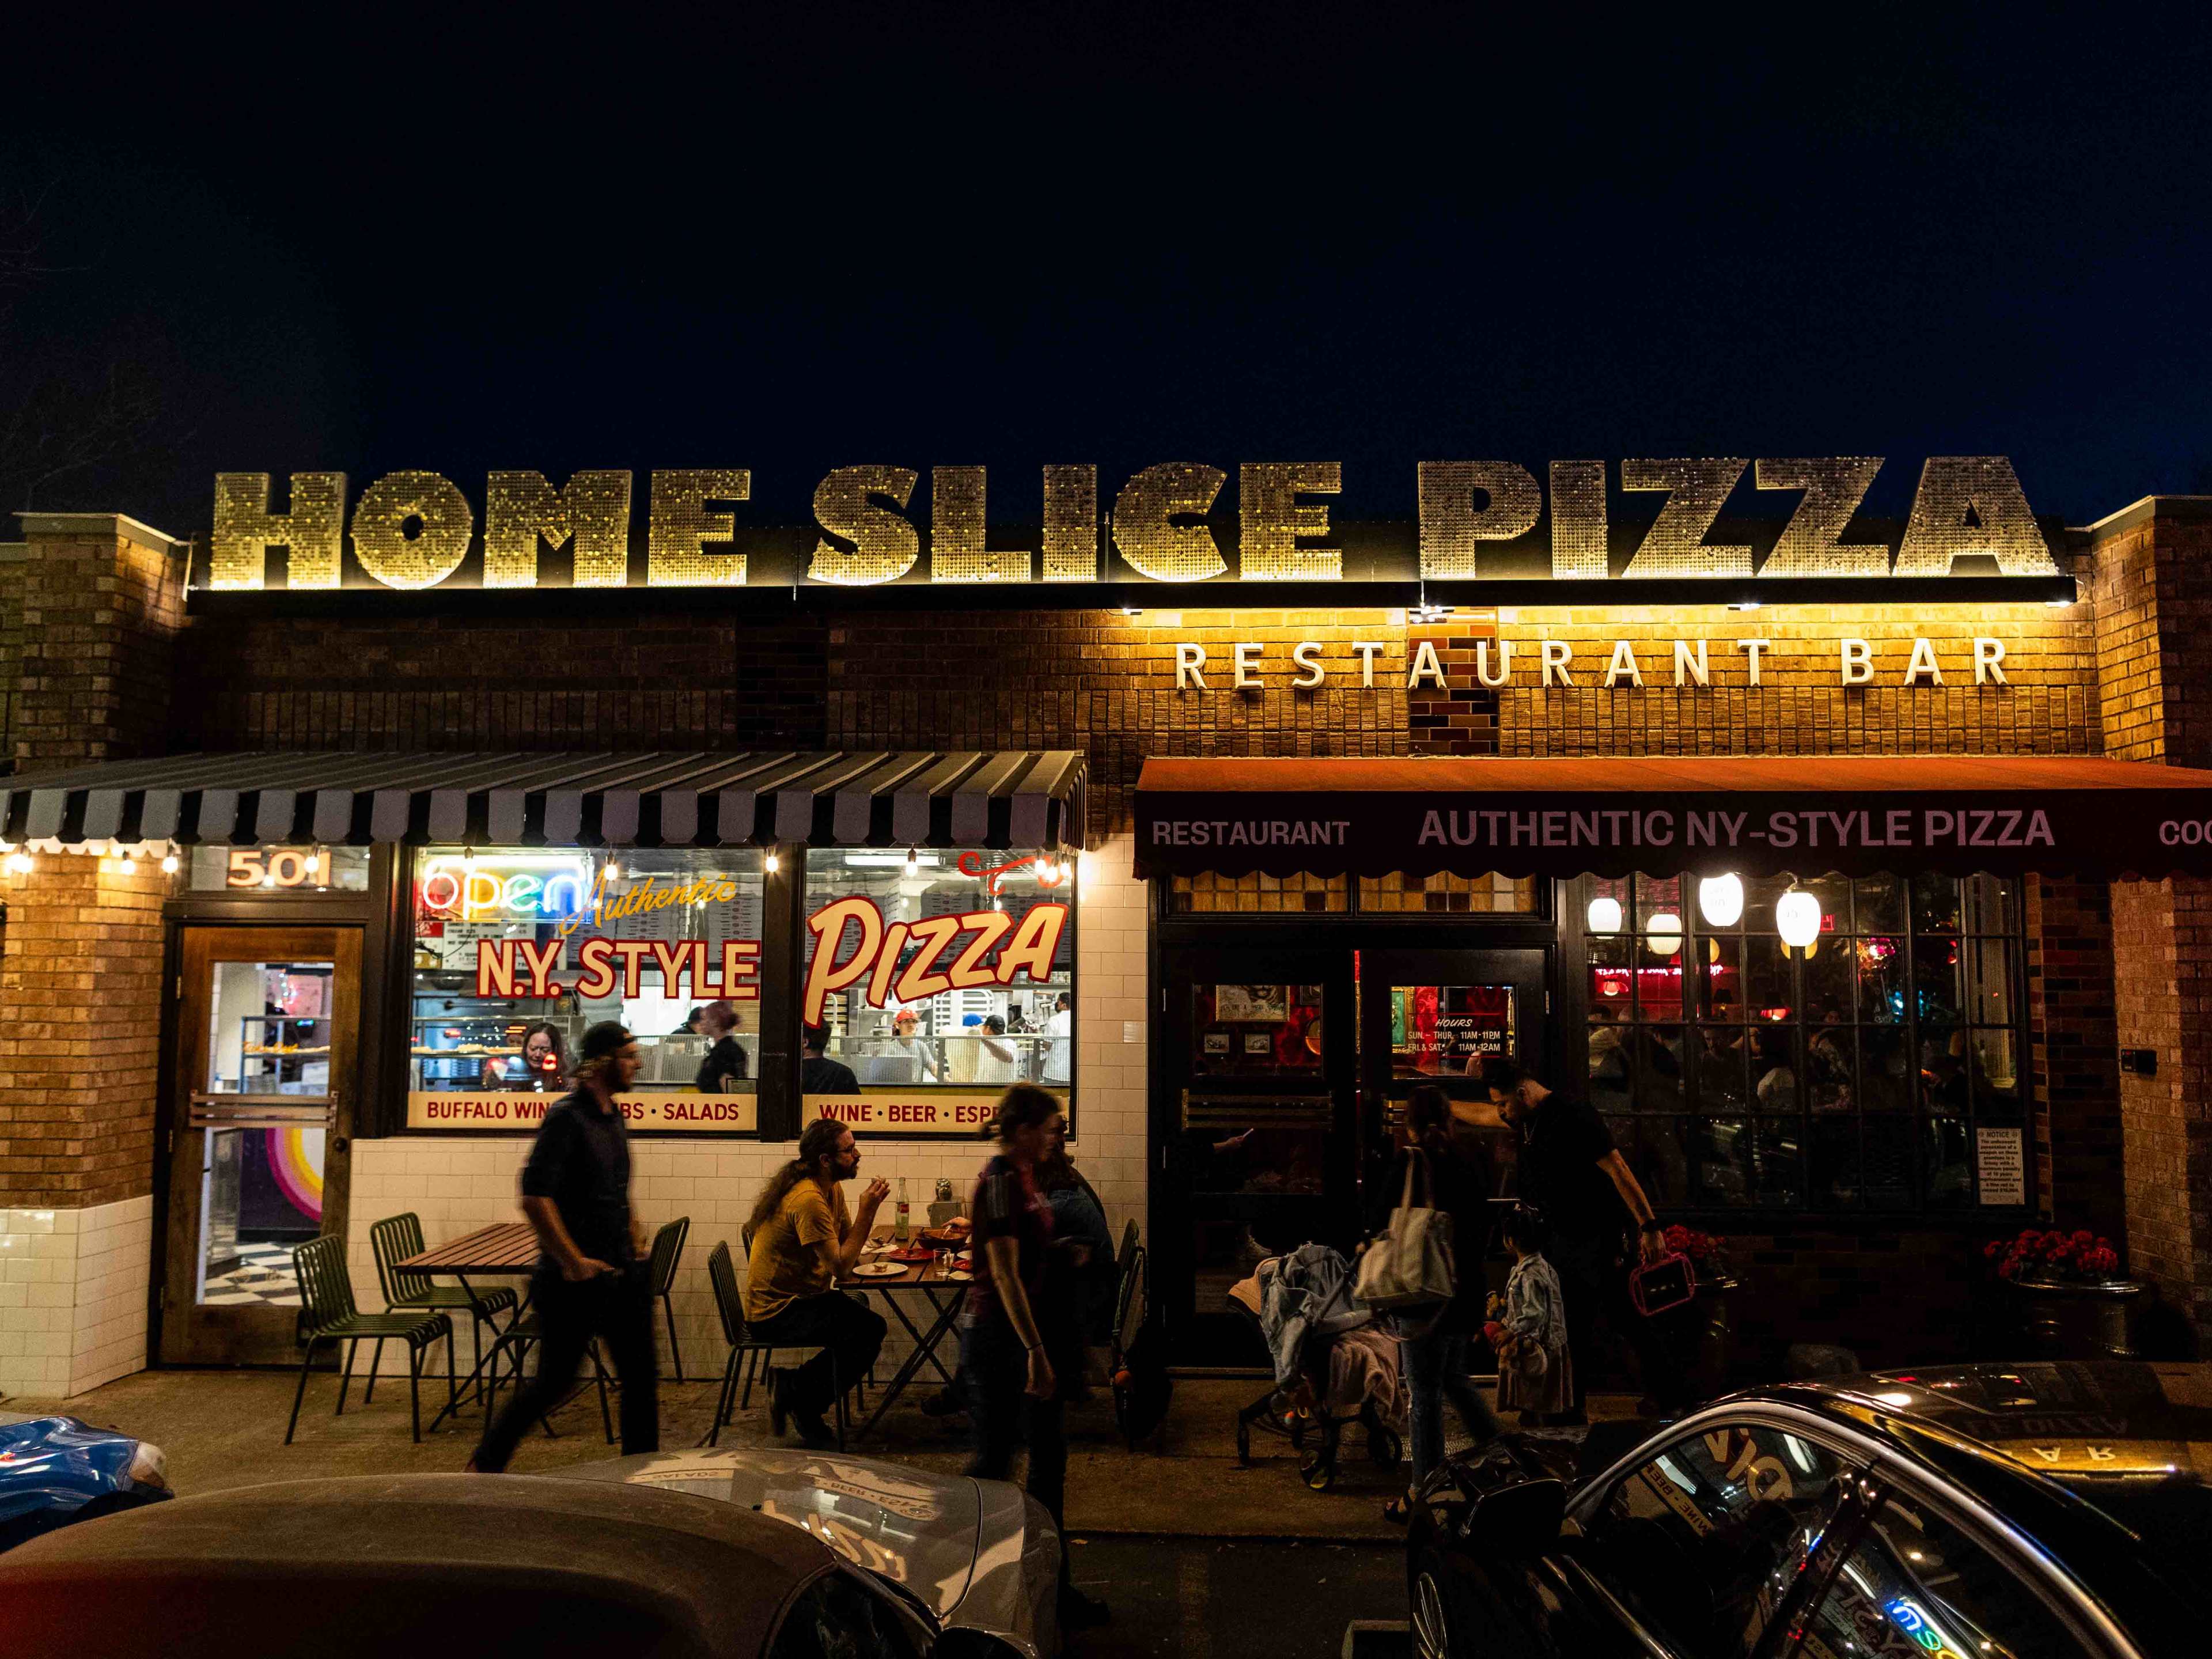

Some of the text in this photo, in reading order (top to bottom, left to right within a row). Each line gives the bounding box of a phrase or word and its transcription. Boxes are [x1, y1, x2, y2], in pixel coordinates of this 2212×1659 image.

[211, 456, 2059, 590] HOME SLICE PIZZA
[1176, 637, 2008, 690] RESTAURANT BAR
[1153, 821, 1350, 845] RESTAURANT
[1418, 810, 1673, 846] AUTHENTIC
[1925, 810, 2055, 846] PIZZA
[227, 850, 332, 887] 501
[559, 866, 737, 935] Authentic
[476, 939, 564, 999] N.Y.
[576, 937, 761, 1000] STYLE
[427, 1101, 550, 1119] BUFFALO WIN
[619, 1103, 738, 1120] BS SALADS
[820, 1105, 872, 1122] WINE
[889, 1105, 936, 1123] BEER
